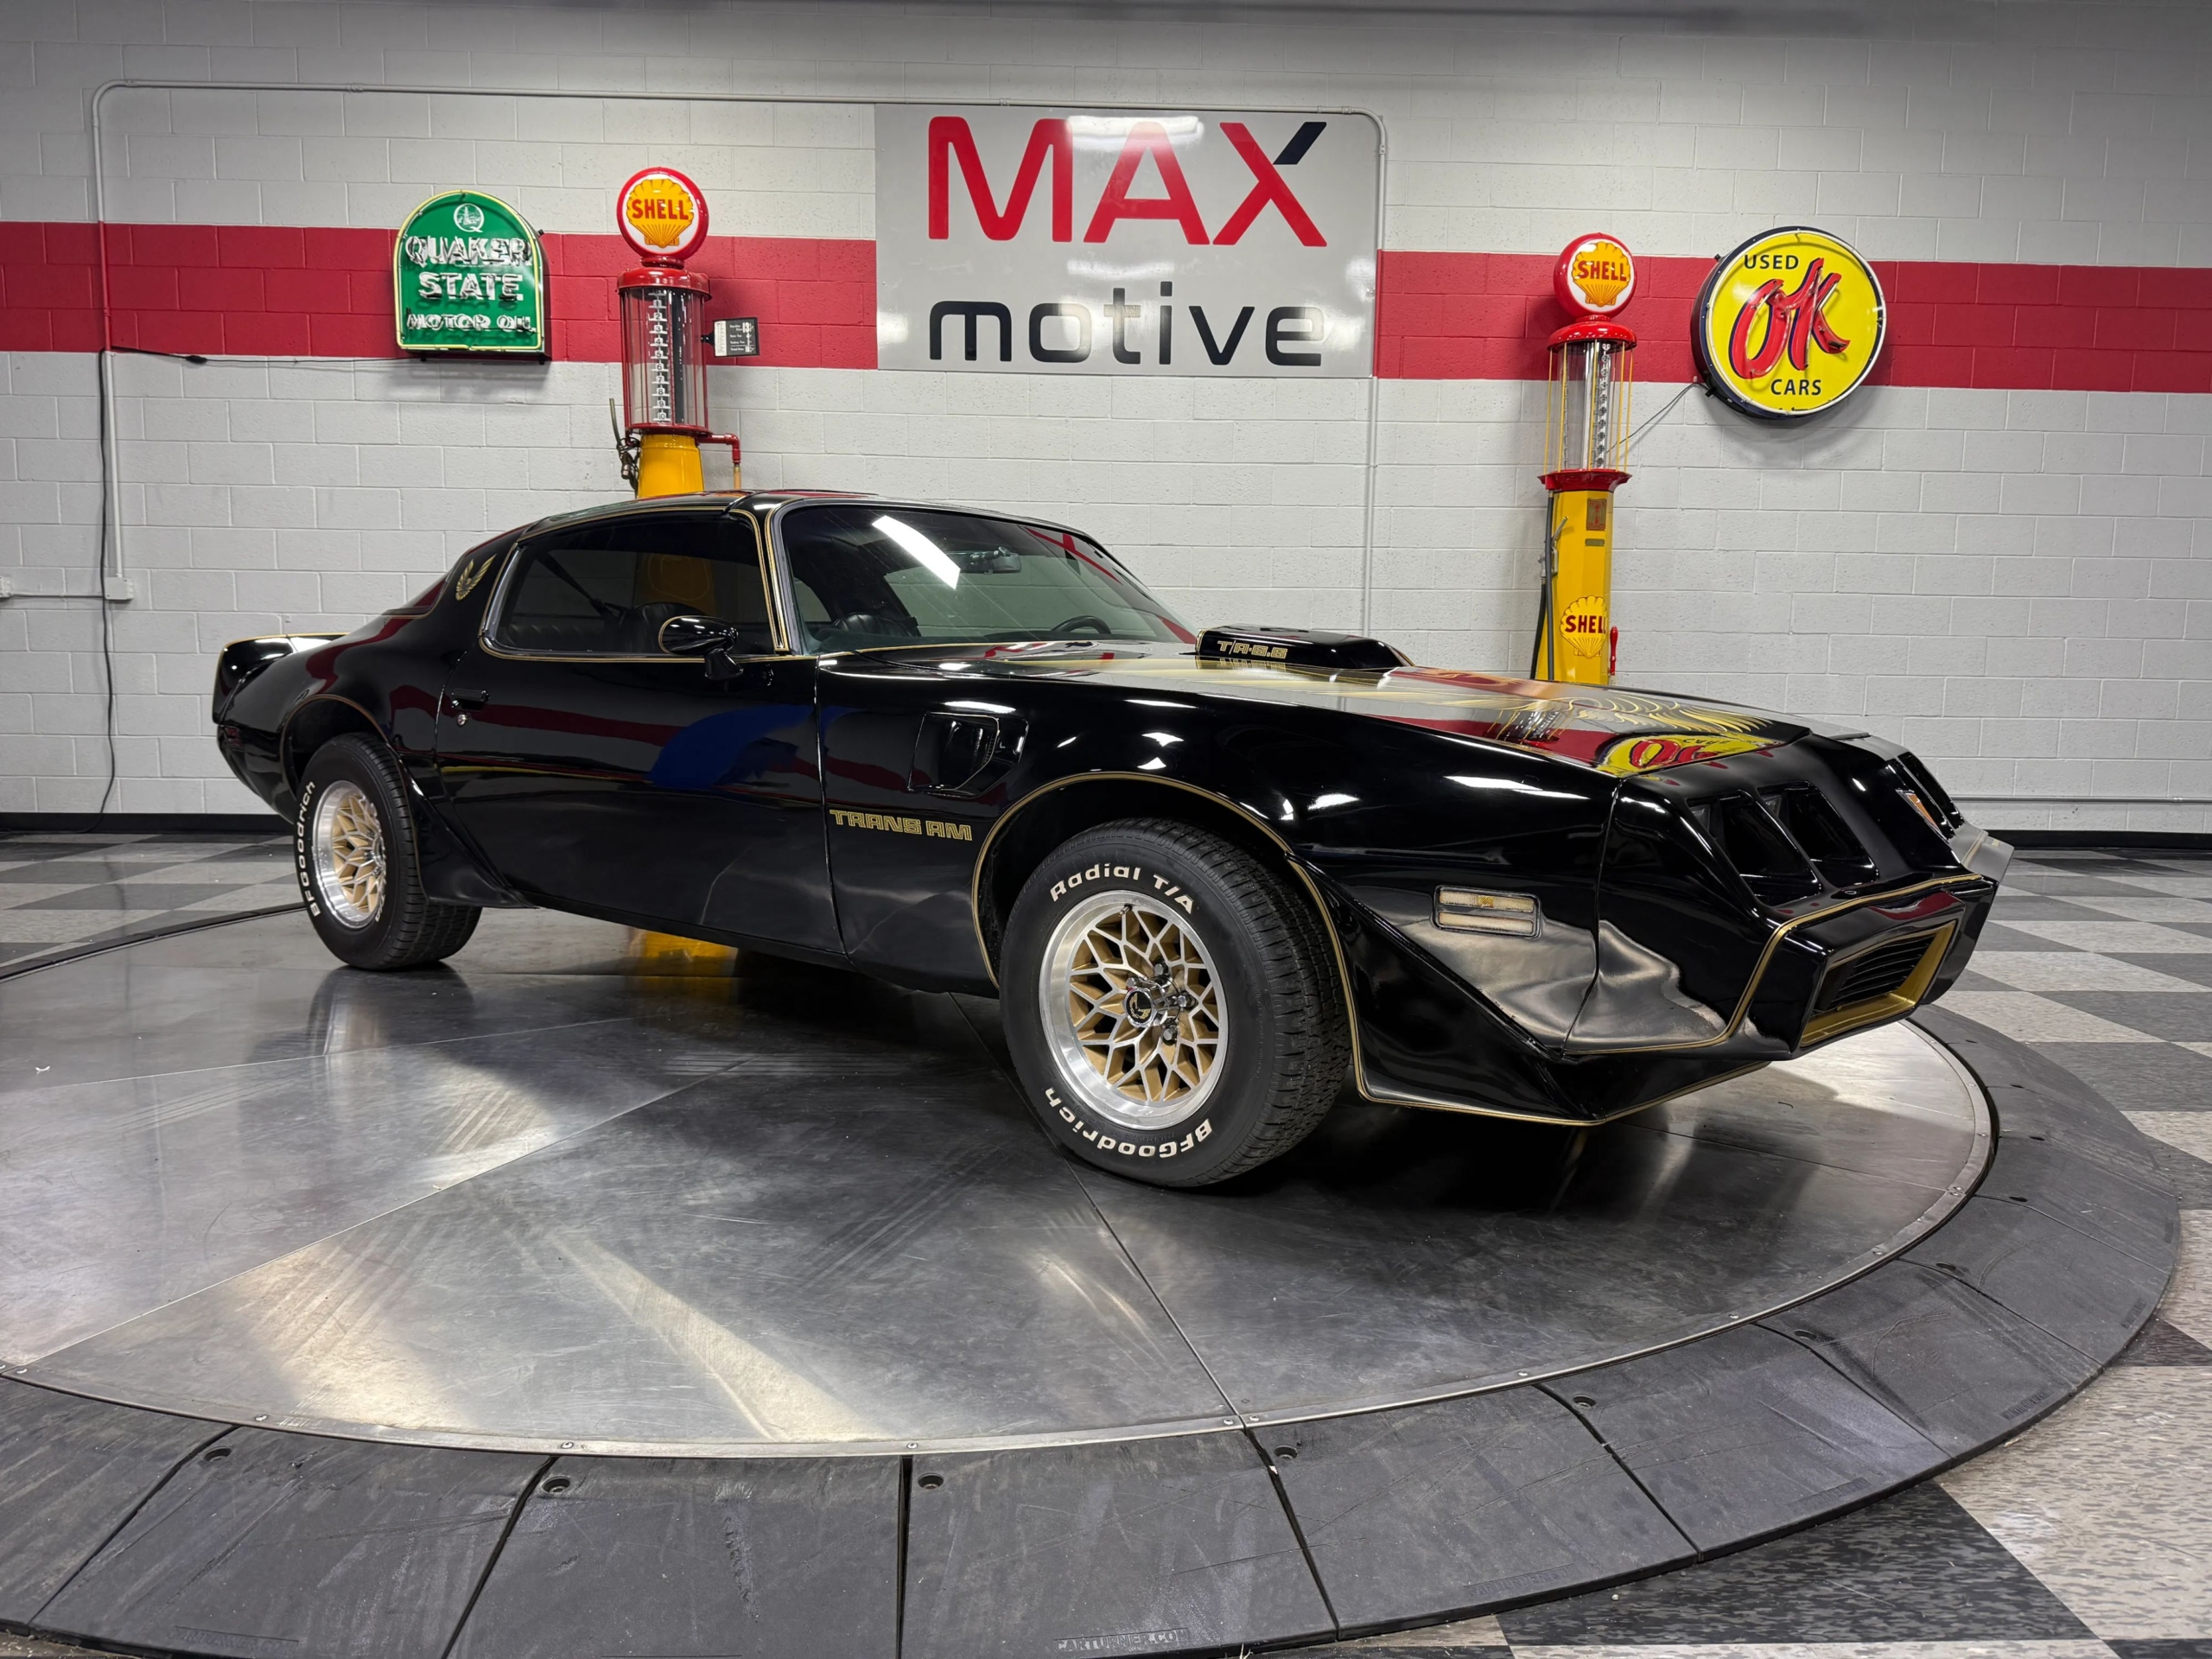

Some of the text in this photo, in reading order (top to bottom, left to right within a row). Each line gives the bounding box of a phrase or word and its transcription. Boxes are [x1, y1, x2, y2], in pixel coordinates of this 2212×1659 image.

[928, 116, 1327, 247] MAX
[632, 199, 689, 220] SHELL
[405, 235, 532, 268] QUAKER
[1743, 254, 1800, 270] USED
[419, 271, 524, 301] STATE
[1578, 260, 1627, 282] SHELL
[406, 313, 536, 333] MOTOR OIL
[930, 281, 1324, 366] motive
[1728, 257, 1851, 379] OK
[1770, 378, 1822, 396] CARS
[830, 809, 973, 841] TRANS AM
[297, 780, 321, 917] BFGoodrich
[1049, 863, 1195, 914] Radial T/A
[1045, 1087, 1213, 1159] BFGoodrich
[1053, 1628, 1191, 1653] CARTURNER.COM
